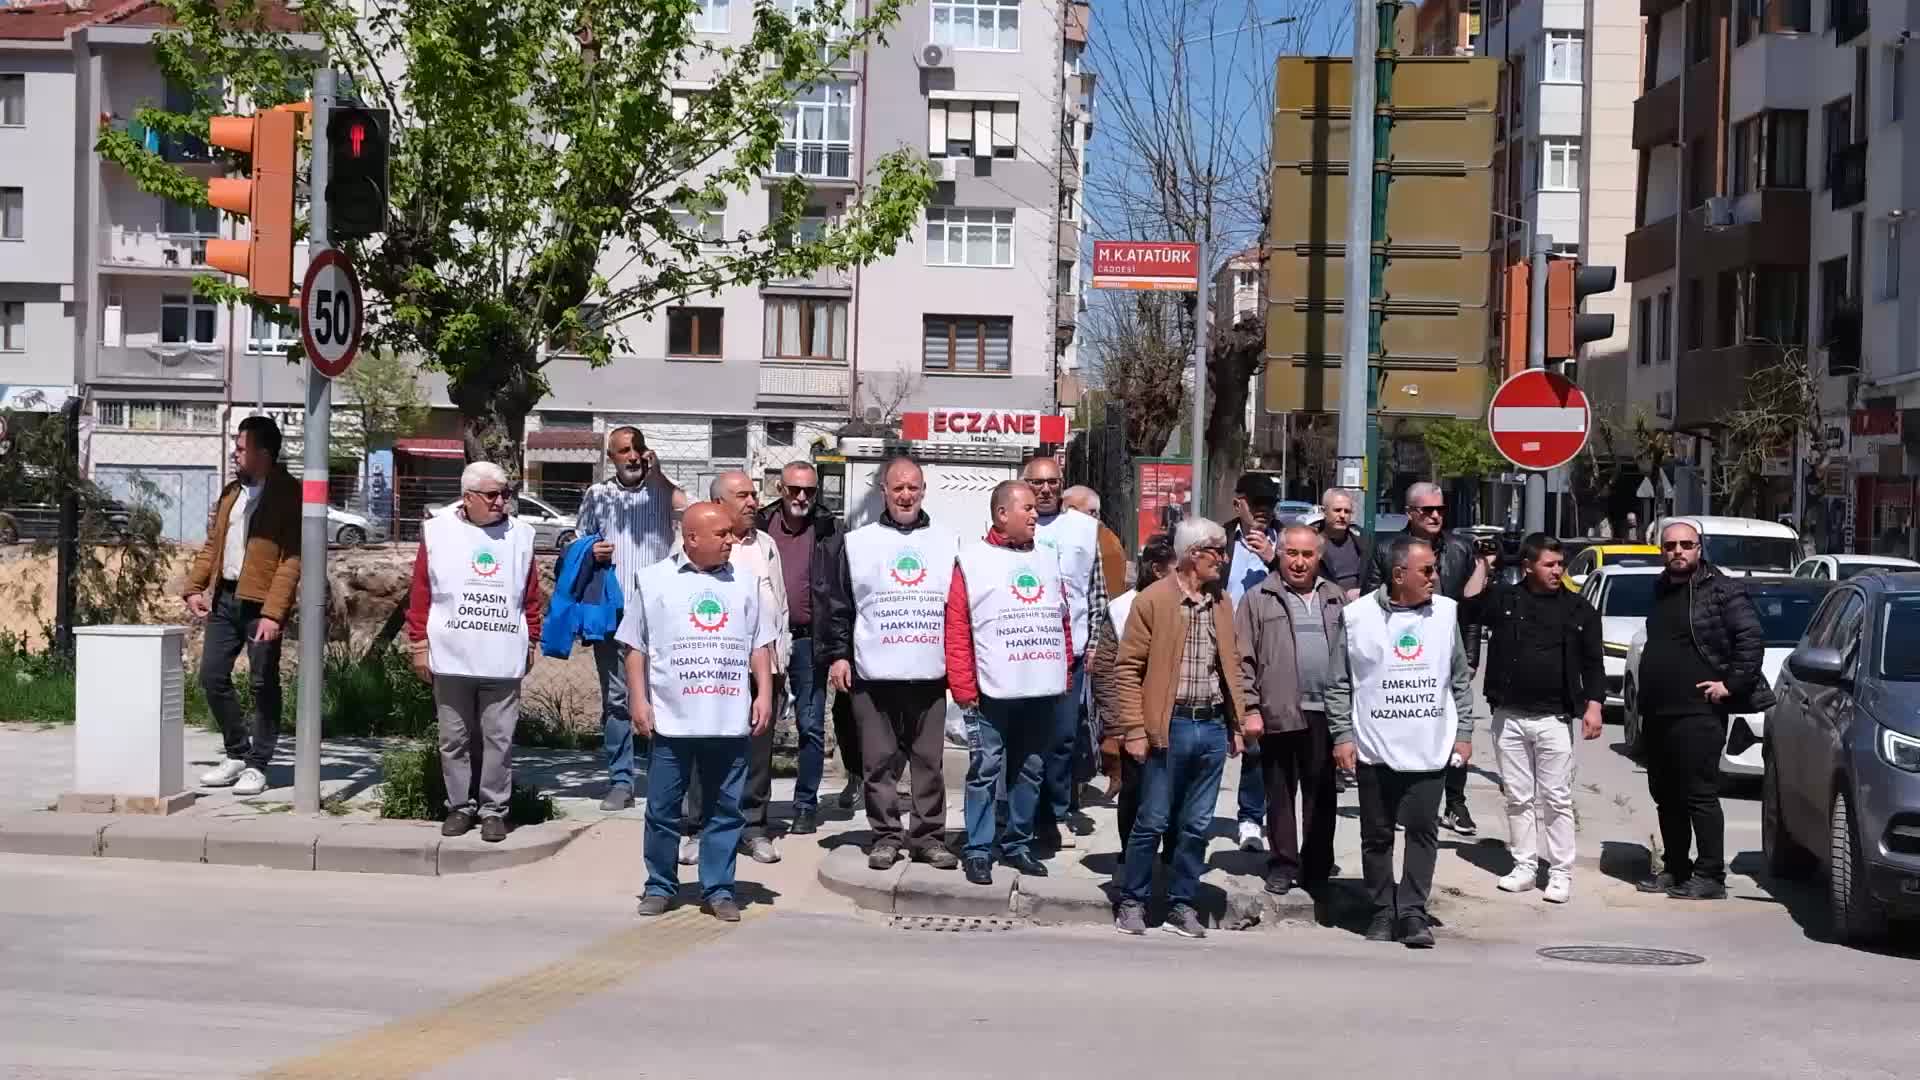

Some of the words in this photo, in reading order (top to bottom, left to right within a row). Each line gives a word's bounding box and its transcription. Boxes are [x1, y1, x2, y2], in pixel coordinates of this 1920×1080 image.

[1099, 247, 1191, 263] M.K.ATATÜRK
[315, 289, 350, 345] 50
[934, 412, 1036, 434] ECZANE
[462, 592, 507, 604] YAŞASIN
[458, 604, 509, 618] ÖRGÜTLÜ
[912, 608, 945, 618] YAŞAMA
[1382, 675, 1437, 689] EMEKLİYİZ
[1385, 693, 1436, 704] HAKLIYIZ
